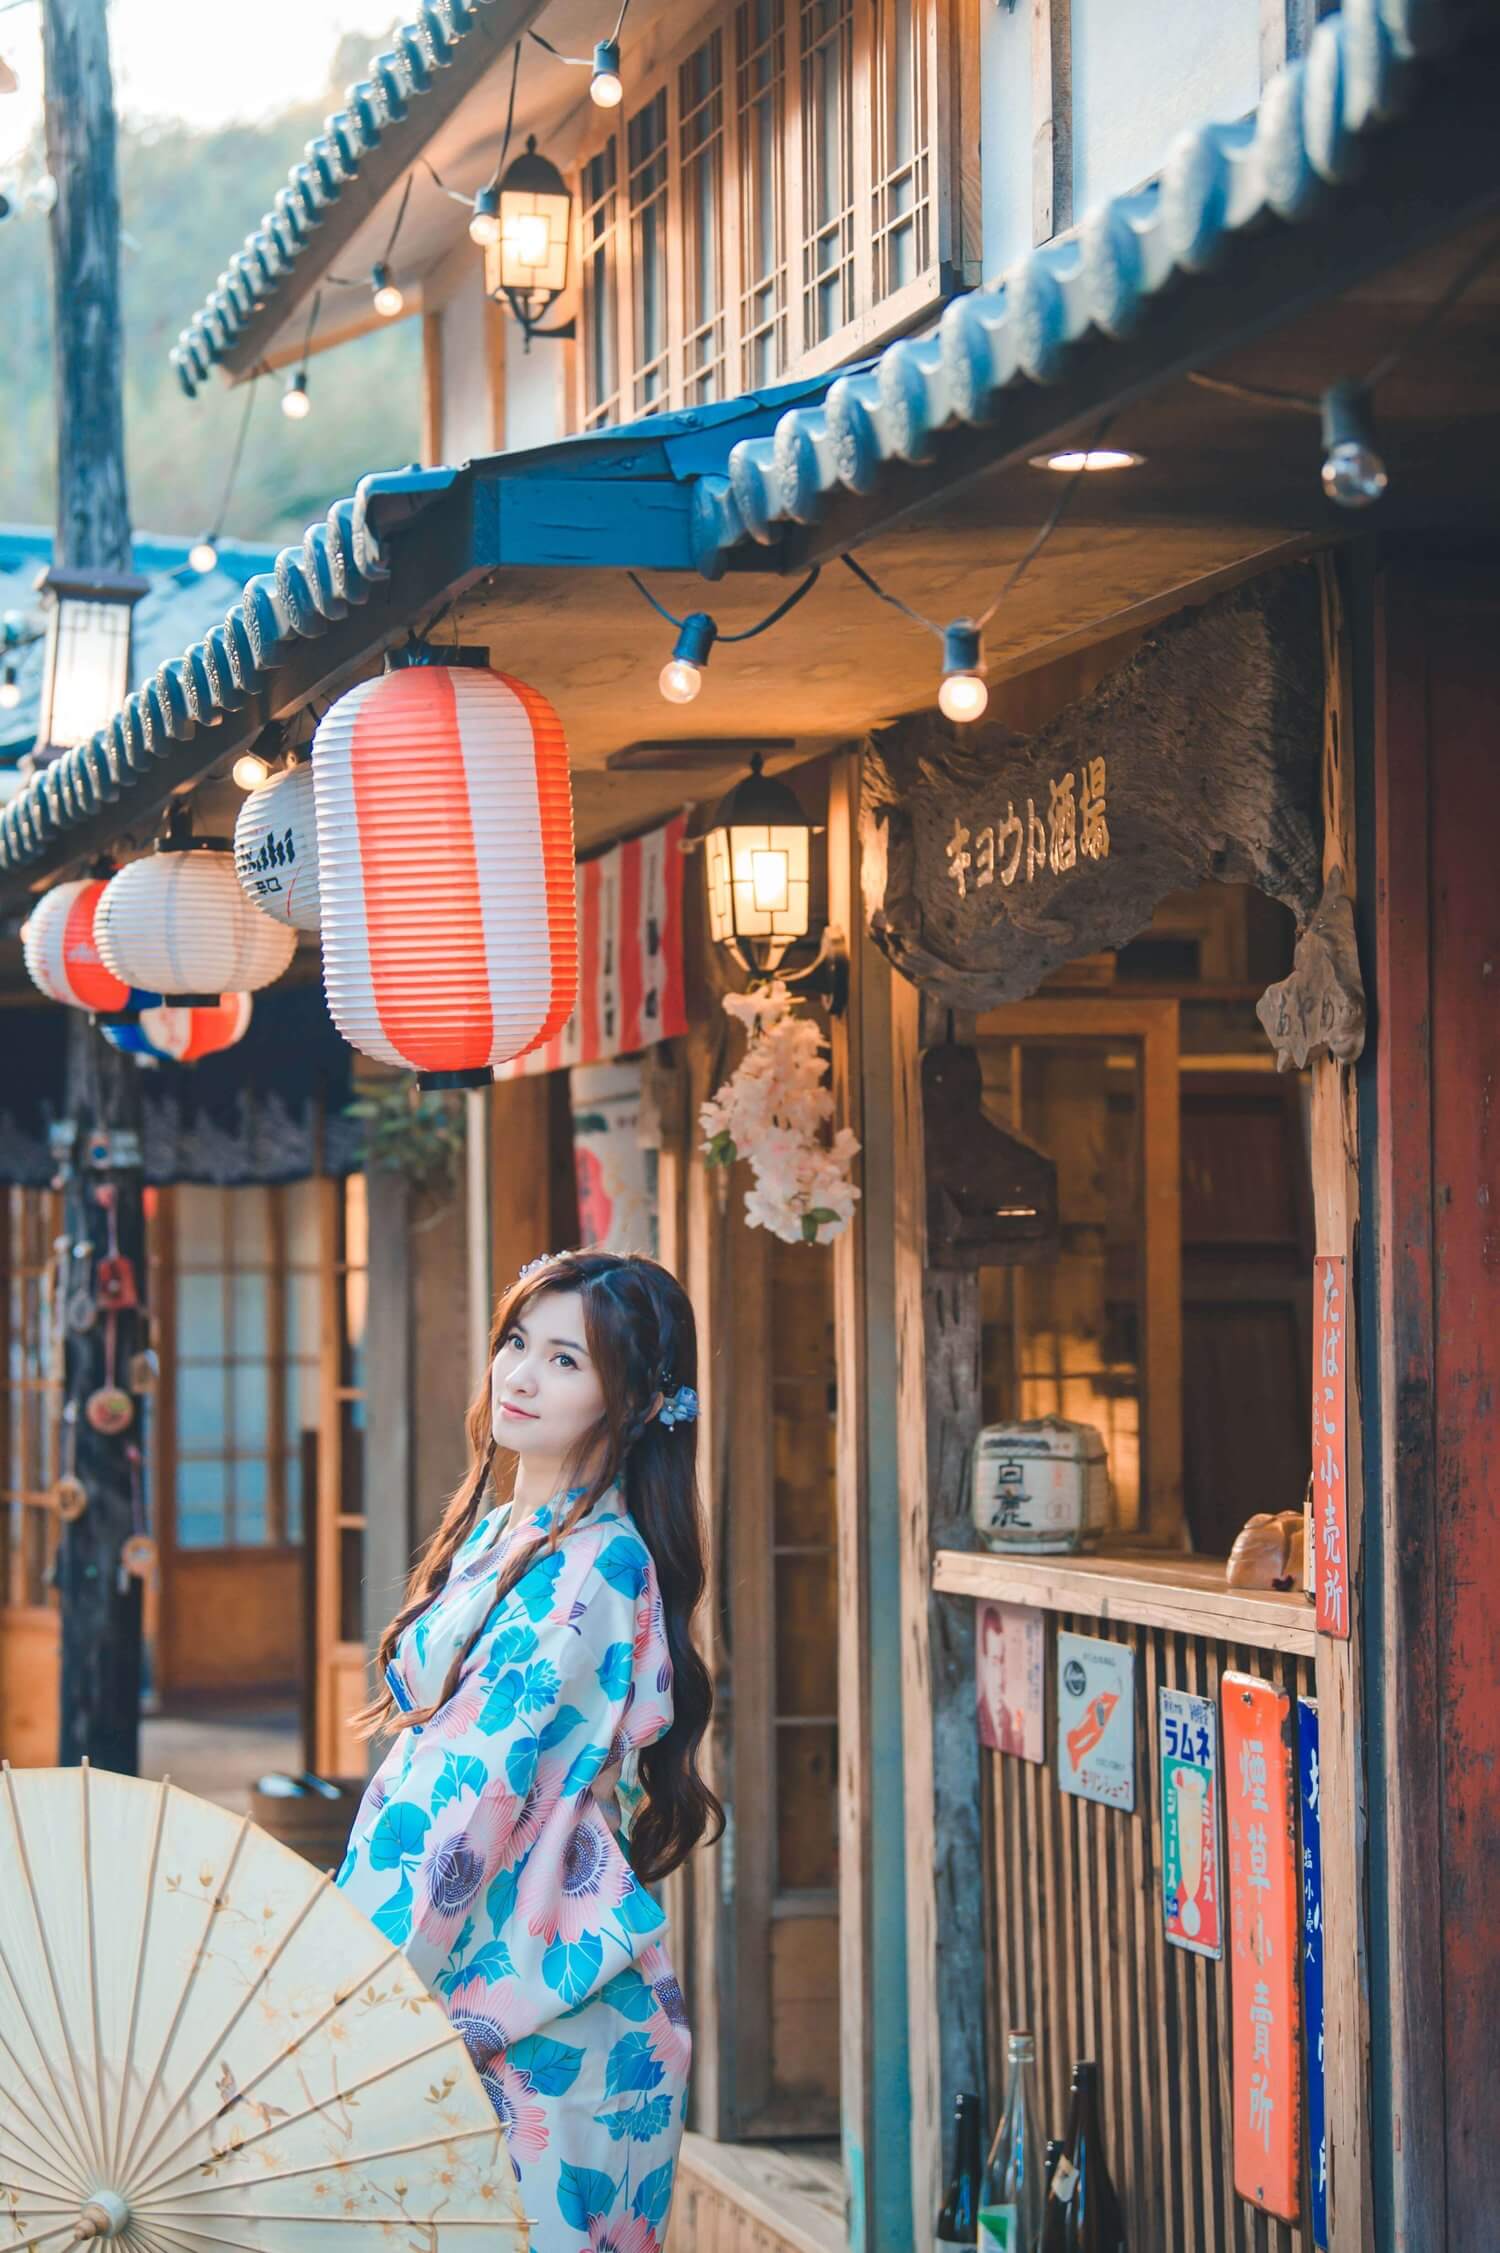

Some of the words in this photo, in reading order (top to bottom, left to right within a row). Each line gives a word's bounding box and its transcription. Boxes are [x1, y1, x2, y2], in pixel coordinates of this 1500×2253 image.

[1321, 1262, 1342, 1631] たばこ小売所
[1165, 1718, 1210, 1766] ラムネ
